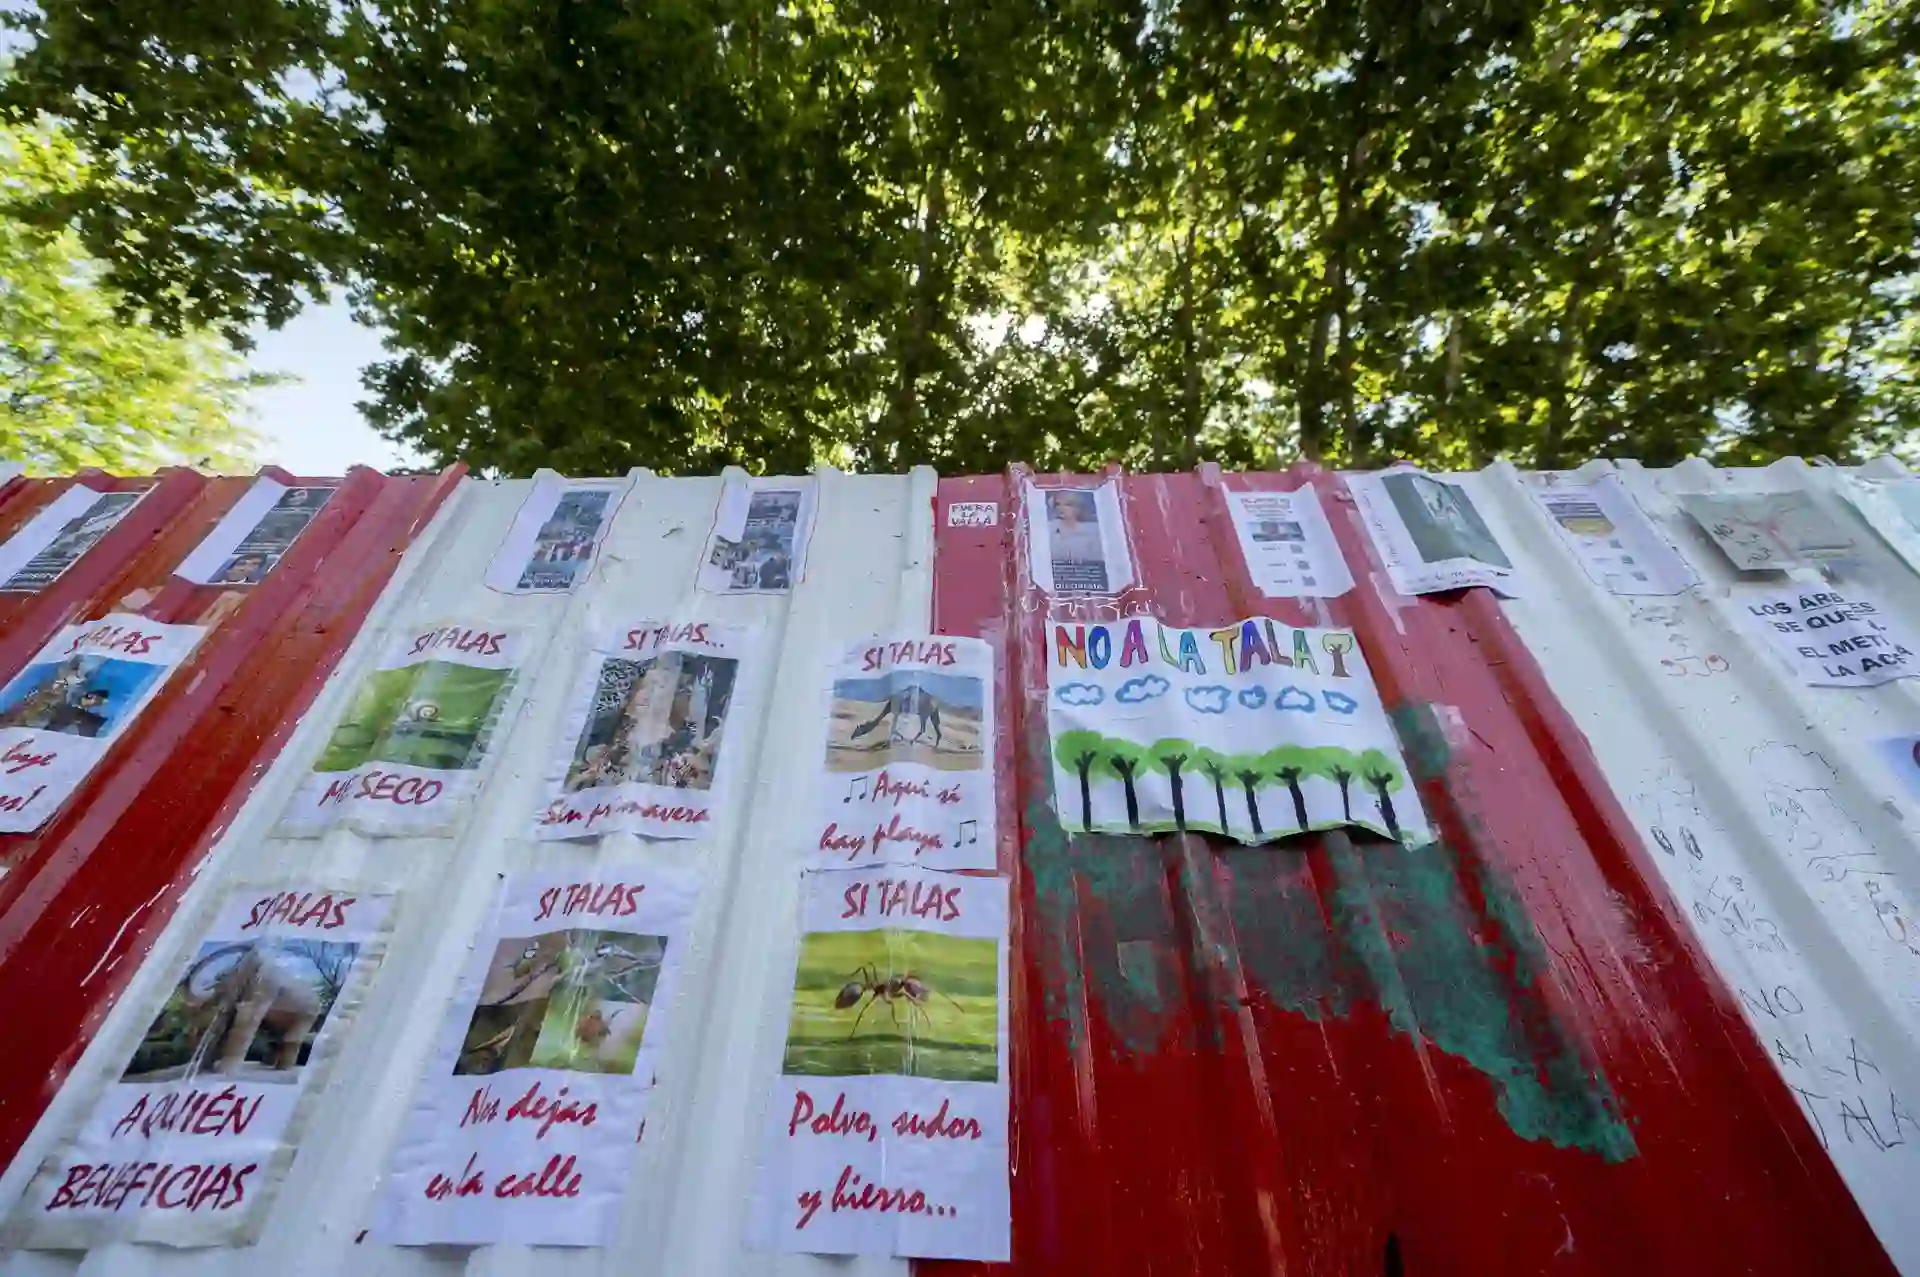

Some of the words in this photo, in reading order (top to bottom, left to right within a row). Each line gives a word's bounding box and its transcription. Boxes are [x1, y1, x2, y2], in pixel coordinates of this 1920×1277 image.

[1748, 601, 1792, 617] LOS
[1773, 621, 1804, 634] SE
[431, 624, 507, 656] TALAS
[623, 630, 648, 650] SI
[861, 646, 884, 671] SI
[888, 639, 957, 667] TALAS
[1055, 625, 1112, 671] NO
[1119, 620, 1149, 668] A
[1157, 620, 1207, 676] LA
[1208, 620, 1320, 676] TALA
[1797, 646, 1829, 659] EL
[1823, 664, 1857, 678] LA
[354, 770, 444, 805] SECO
[819, 822, 867, 862] hay
[872, 813, 944, 856] playa
[264, 891, 357, 930] TALAS
[533, 887, 562, 922] SI
[561, 882, 646, 917] TALAS
[841, 882, 870, 919] SI
[876, 879, 961, 922] TALAS
[1739, 984, 1805, 1018] NO
[505, 1081, 598, 1140] dejas
[788, 1090, 878, 1142] Polvo,
[892, 1098, 982, 1140] sudor
[45, 1161, 258, 1212] BENEFICIAS
[494, 1153, 583, 1199] calle
[796, 1189, 822, 1230] y
[831, 1164, 957, 1218] hierro...
